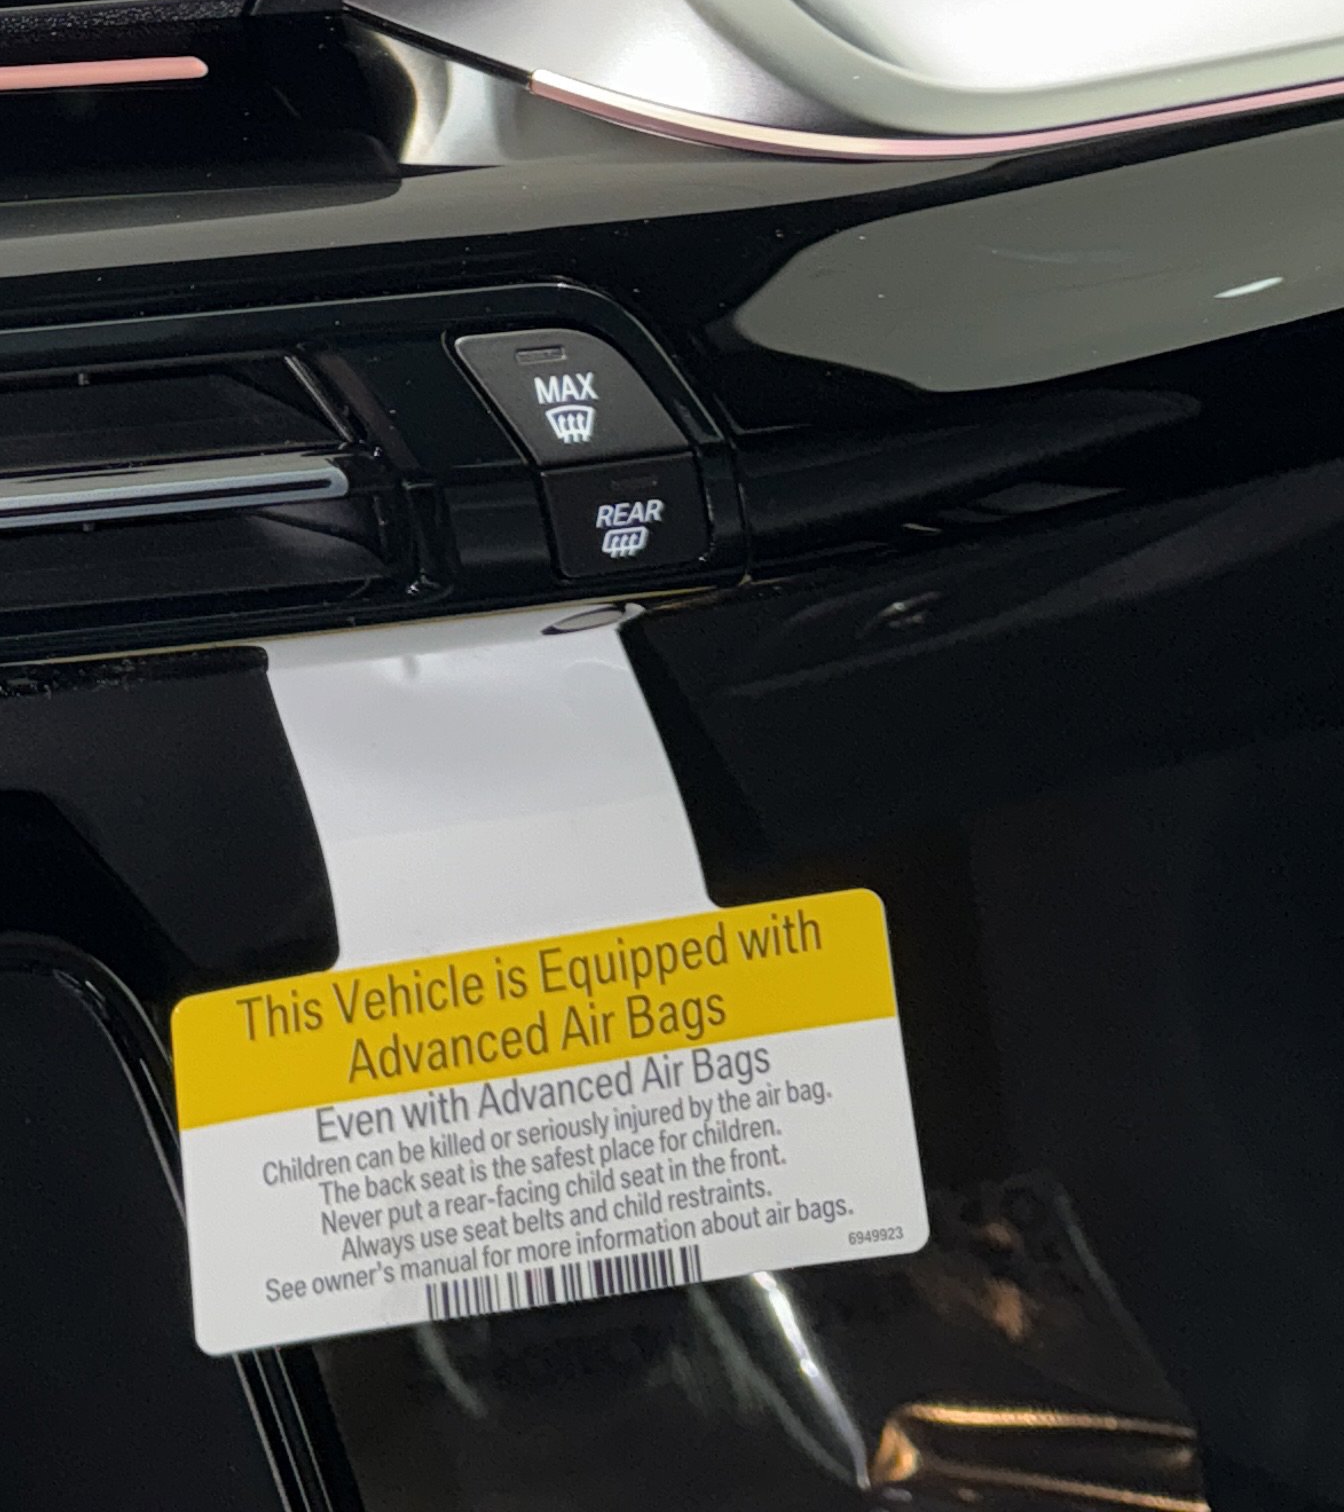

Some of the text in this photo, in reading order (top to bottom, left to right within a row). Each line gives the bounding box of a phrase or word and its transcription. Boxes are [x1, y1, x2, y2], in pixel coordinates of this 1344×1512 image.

[534, 371, 600, 405] MAX
[596, 498, 664, 529] REAR
[236, 909, 822, 1041] This Vehicle is Equipped with
[348, 991, 727, 1083] Advanced Air Bags
[262, 1078, 833, 1187] Children can be killed or seriously injured by the air bag.
[315, 1045, 771, 1143] Even with Advanced Air Bags
[318, 1117, 783, 1207] The back seat is the safest place for children.
[320, 1143, 787, 1236] Never put a rear-facing child seat in the front.
[264, 1195, 854, 1303] See owner's manual for more information about air bags.
[341, 1177, 773, 1262] Always use seat belts and child restraints.
[847, 1226, 905, 1246] 6949923
